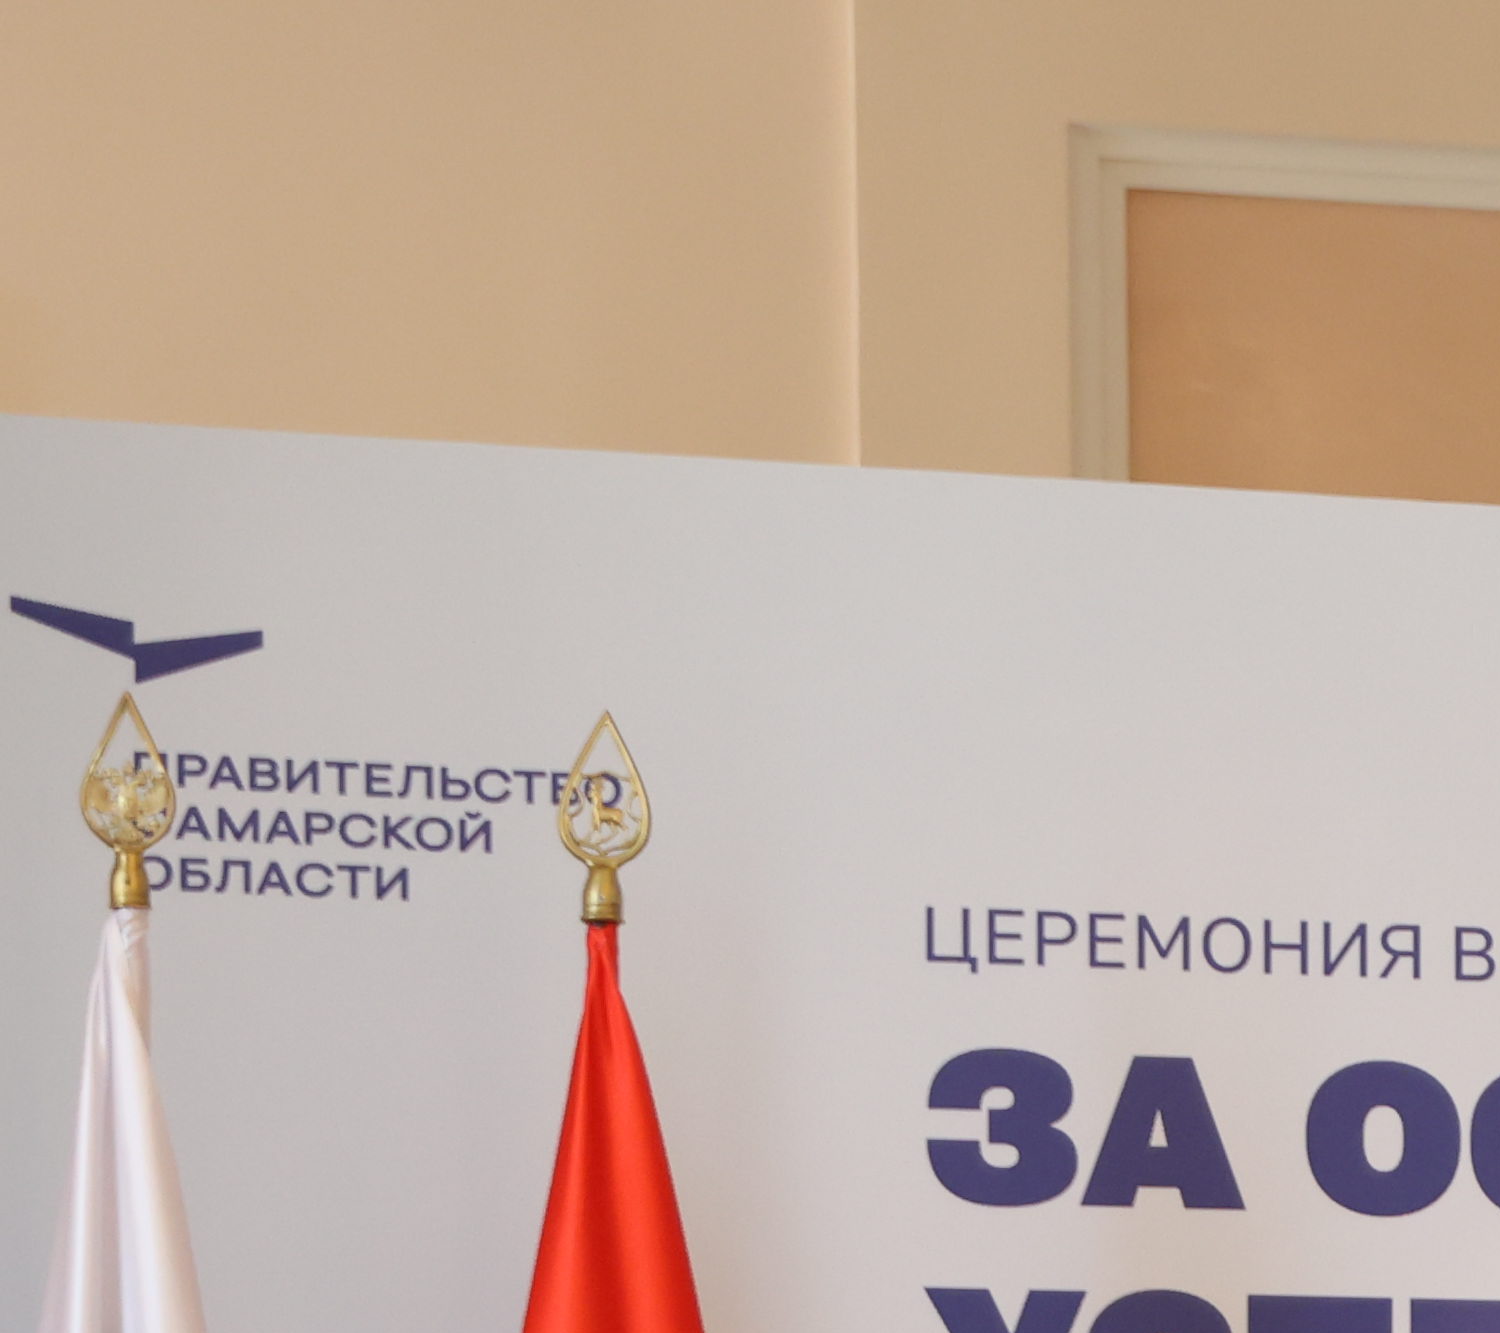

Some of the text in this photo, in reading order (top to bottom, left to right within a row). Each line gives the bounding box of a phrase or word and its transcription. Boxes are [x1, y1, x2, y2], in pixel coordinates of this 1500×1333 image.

[132, 805, 493, 853] АМАРСКОЙ
[142, 855, 409, 901] ОБЛАСТИ
[926, 906, 1421, 979] ЦЕРЕМОНИЯ
[927, 1048, 1246, 1211] ЗА
